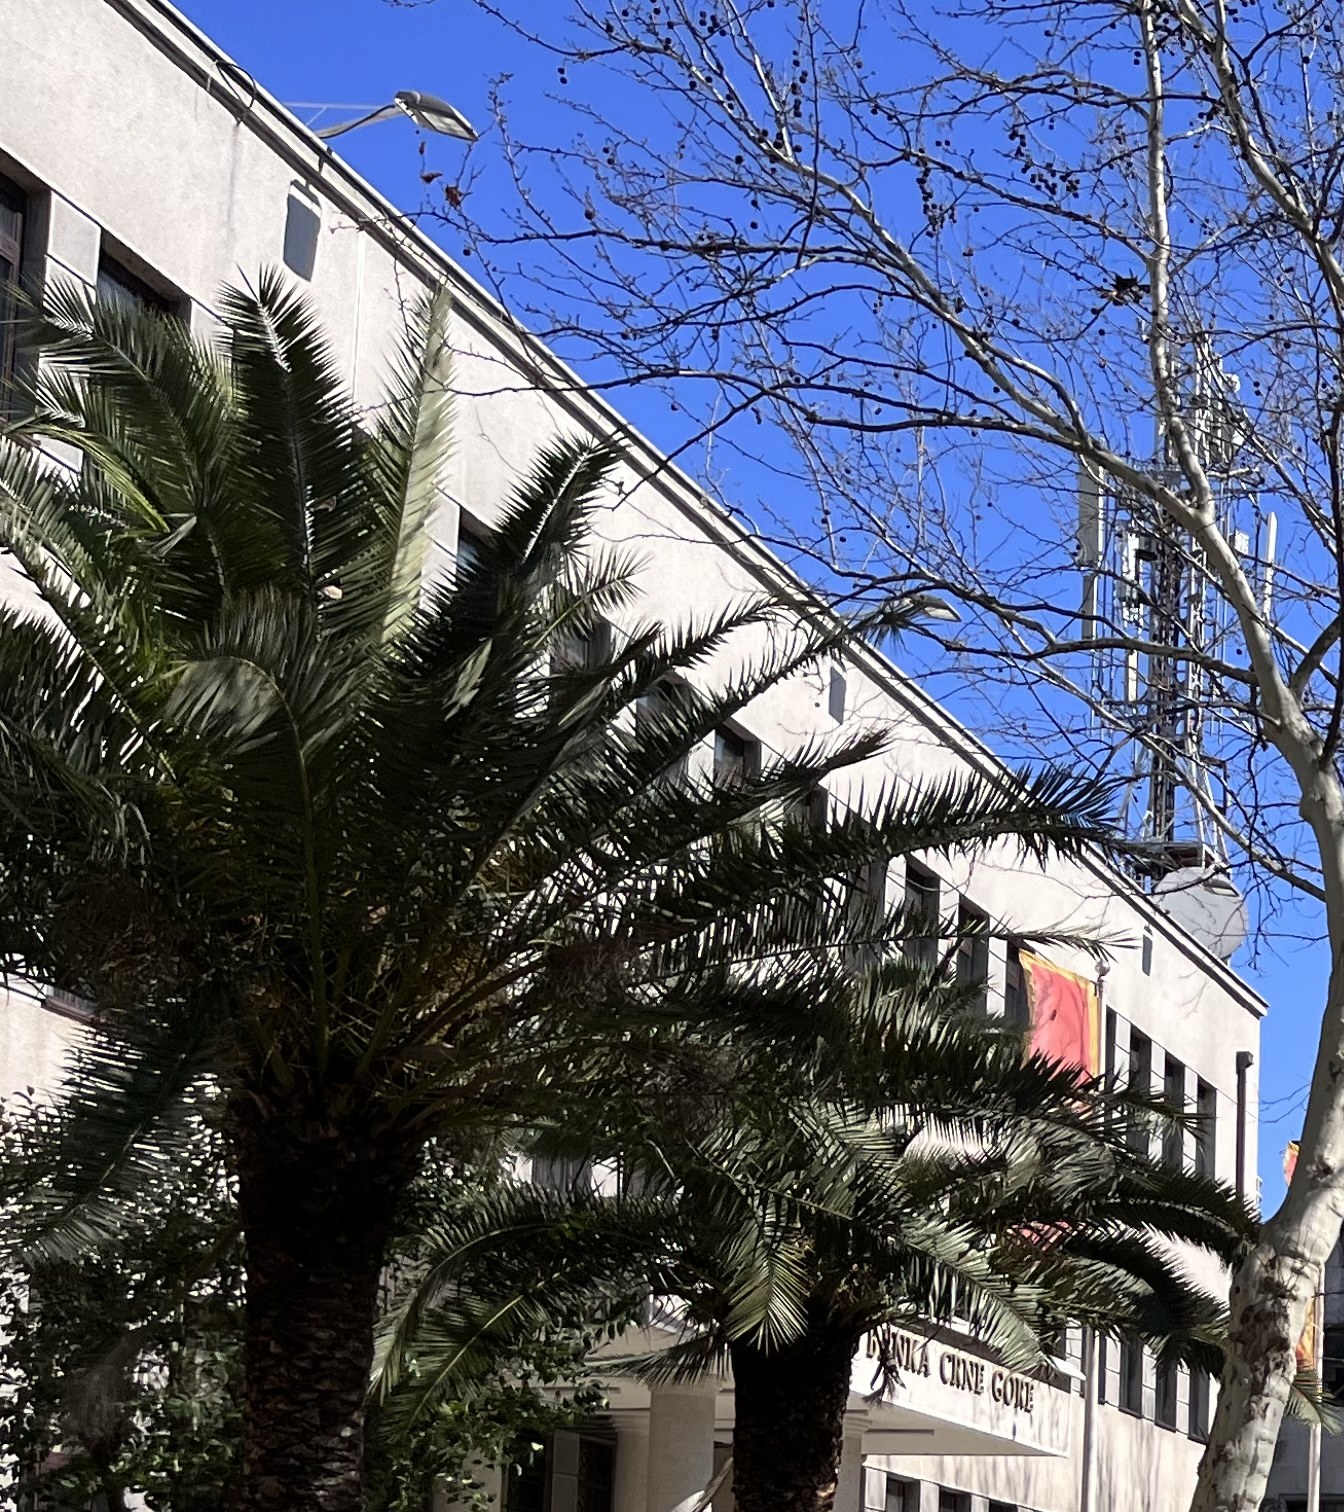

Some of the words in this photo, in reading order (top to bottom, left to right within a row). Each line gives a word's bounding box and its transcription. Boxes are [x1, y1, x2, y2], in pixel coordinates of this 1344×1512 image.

[866, 1329, 931, 1377] BNKA
[939, 1351, 985, 1395] CRNE
[992, 1370, 1034, 1413] GORE
